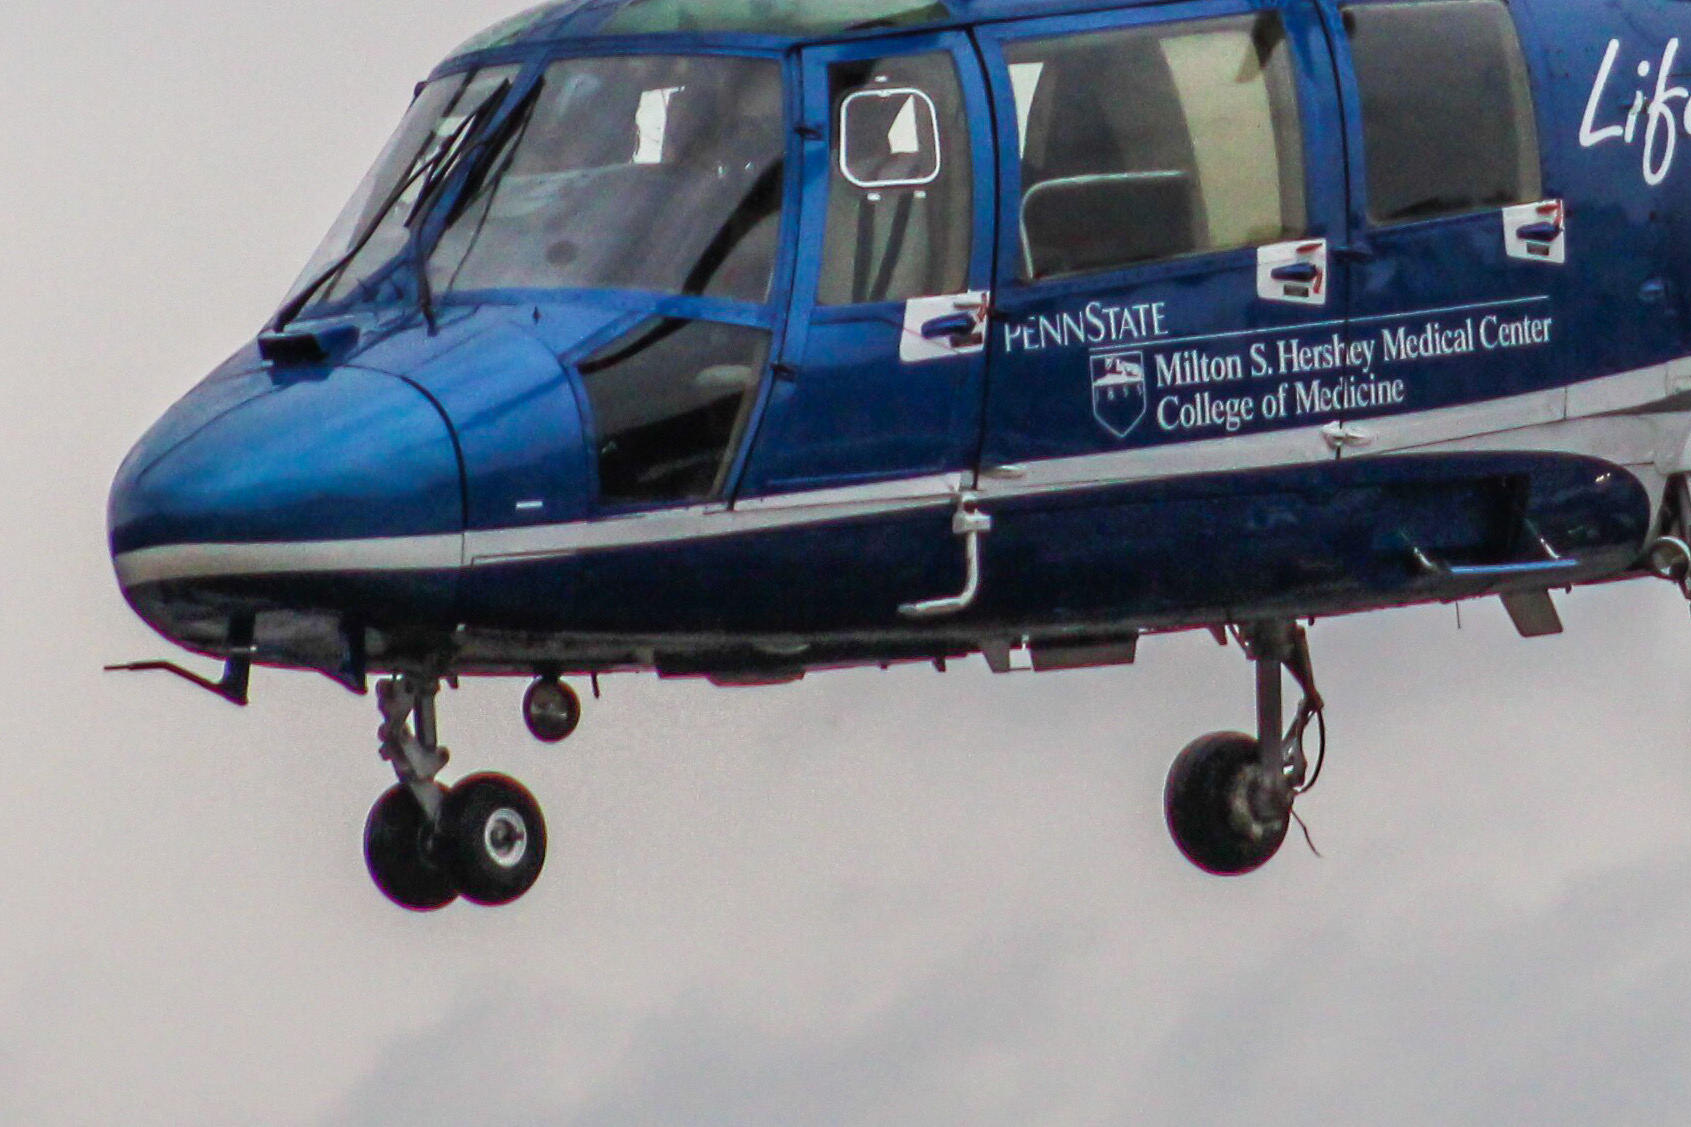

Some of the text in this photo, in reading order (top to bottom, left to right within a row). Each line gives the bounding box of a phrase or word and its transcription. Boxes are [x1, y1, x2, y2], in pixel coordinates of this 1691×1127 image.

[1154, 315, 1552, 388] Milton S. Hershey Medical Center
[1157, 373, 1405, 432] College of Medicine
